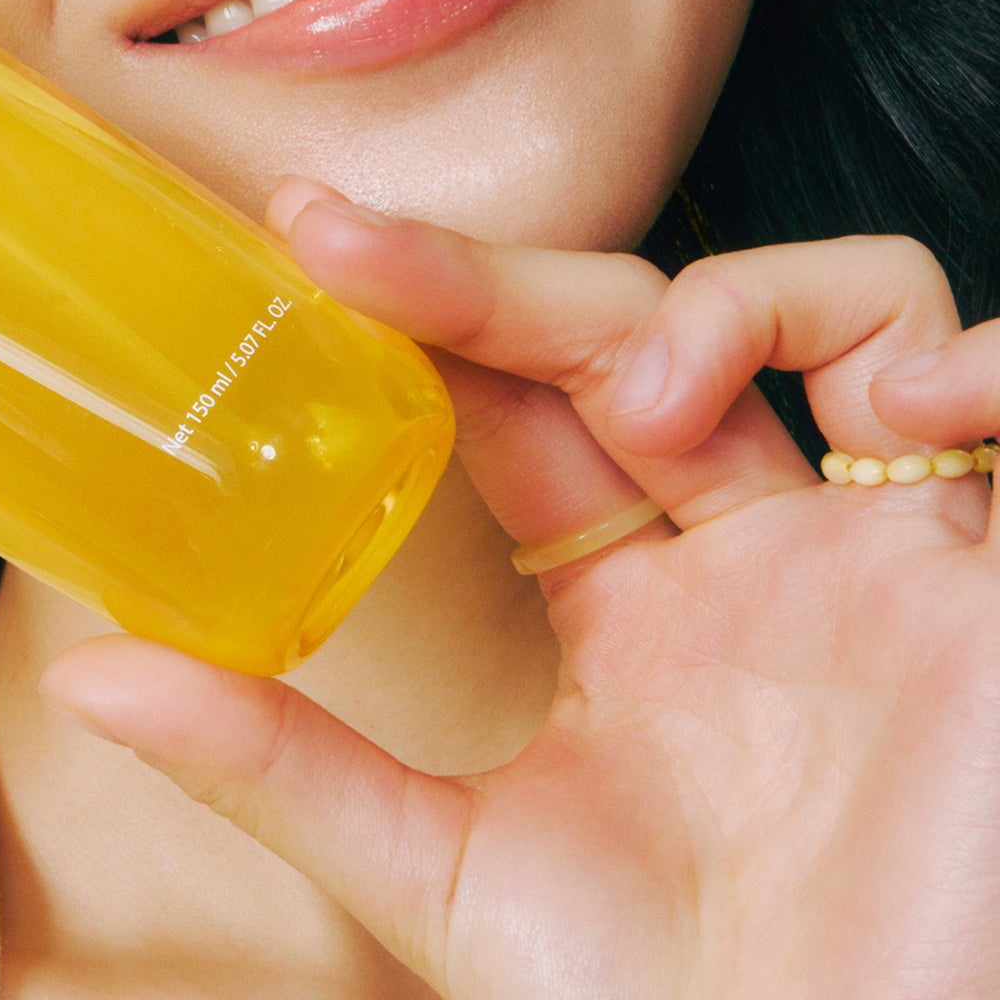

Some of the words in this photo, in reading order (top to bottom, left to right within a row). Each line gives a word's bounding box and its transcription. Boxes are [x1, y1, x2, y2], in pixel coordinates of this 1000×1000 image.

[267, 296, 293, 318] OZ.
[251, 320, 277, 338] FL.
[230, 334, 259, 367] 5.07
[224, 361, 238, 378] /
[210, 371, 232, 396] ml
[186, 393, 216, 423] 150
[161, 423, 194, 456] Net
